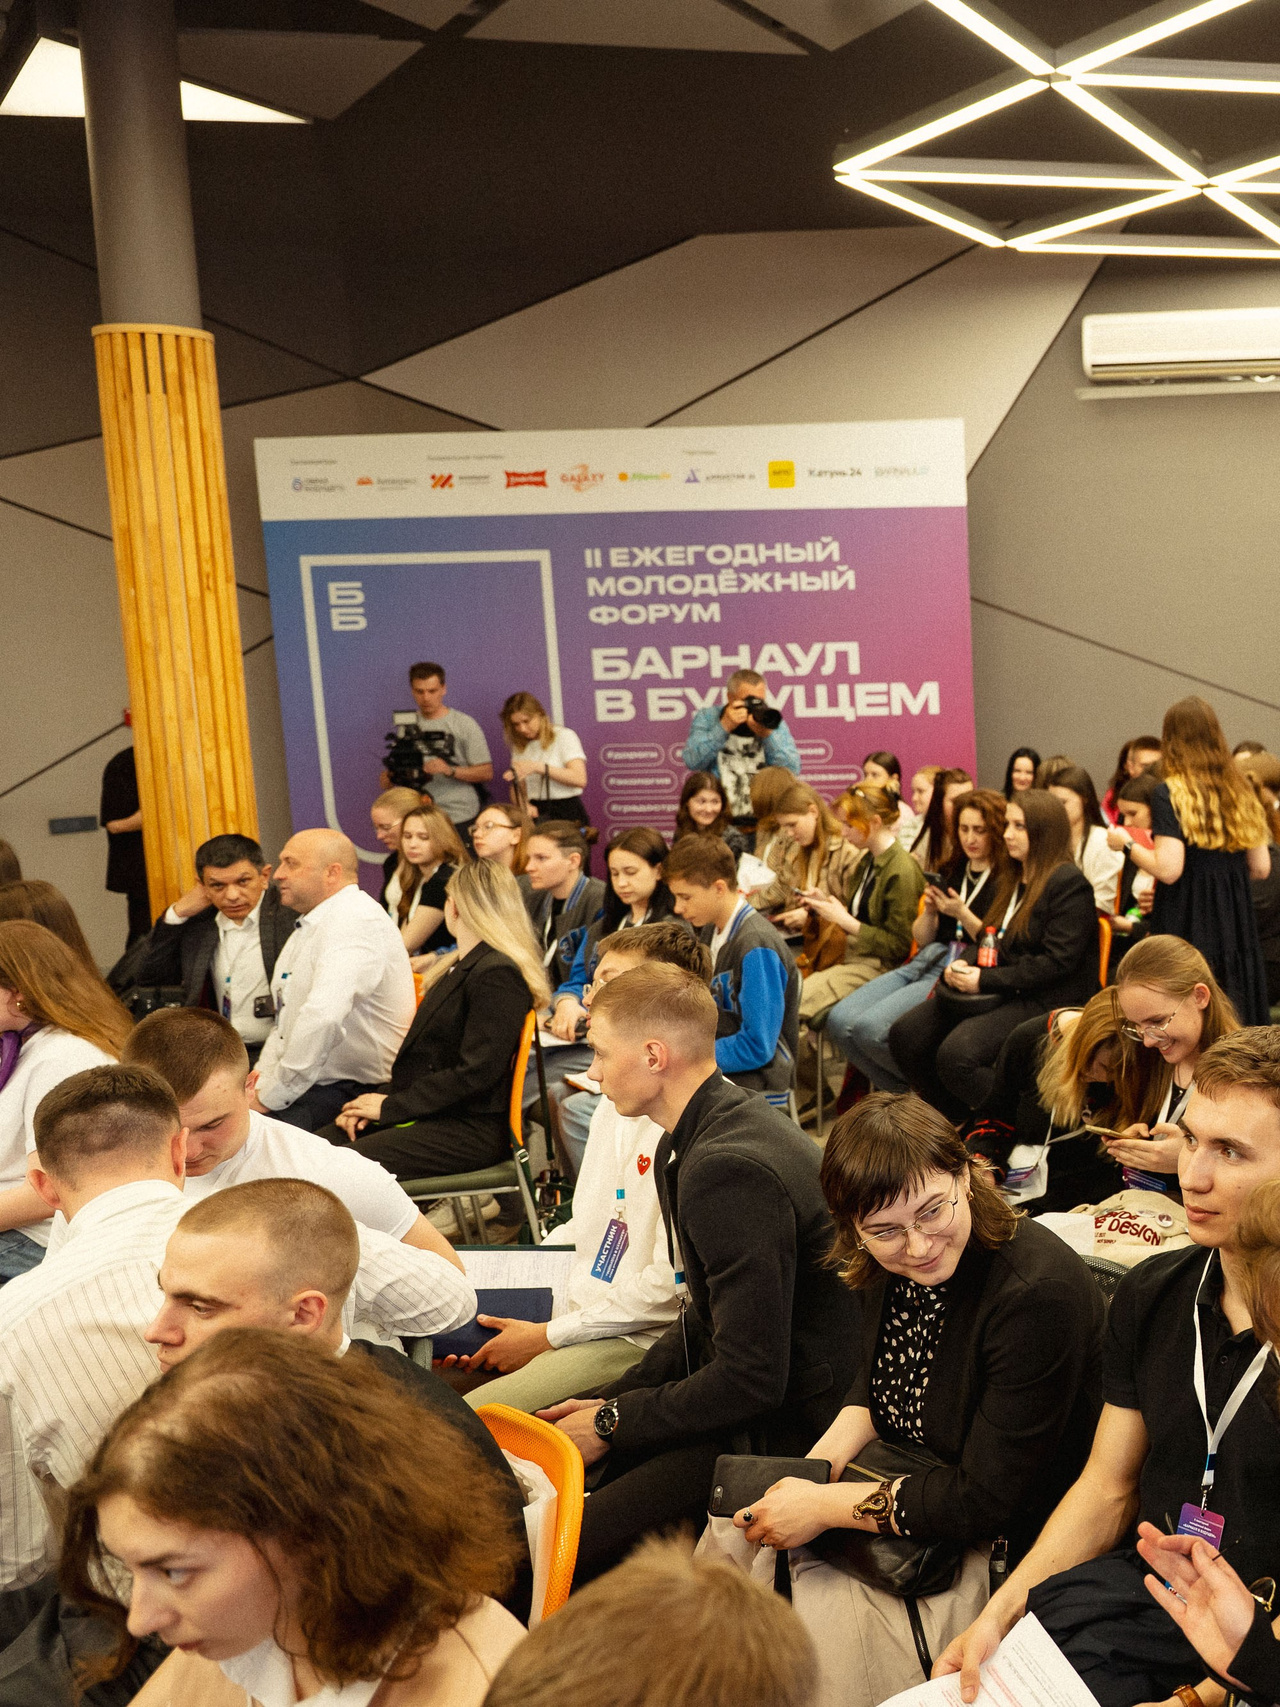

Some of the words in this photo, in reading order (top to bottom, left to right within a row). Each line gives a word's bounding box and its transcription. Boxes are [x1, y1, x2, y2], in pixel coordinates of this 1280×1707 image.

[584, 547, 602, 568] II
[609, 536, 841, 569] ЕЖЕГОДНЫЙ
[586, 564, 857, 598] МОЛОДЁЖНЫЙ
[588, 602, 721, 625] ФОРУМ
[590, 640, 861, 682] БАРНАУЛ
[594, 688, 637, 723] В
[646, 680, 941, 722] БУУЩЕМ
[594, 1224, 618, 1273] УЧАСТНИК
